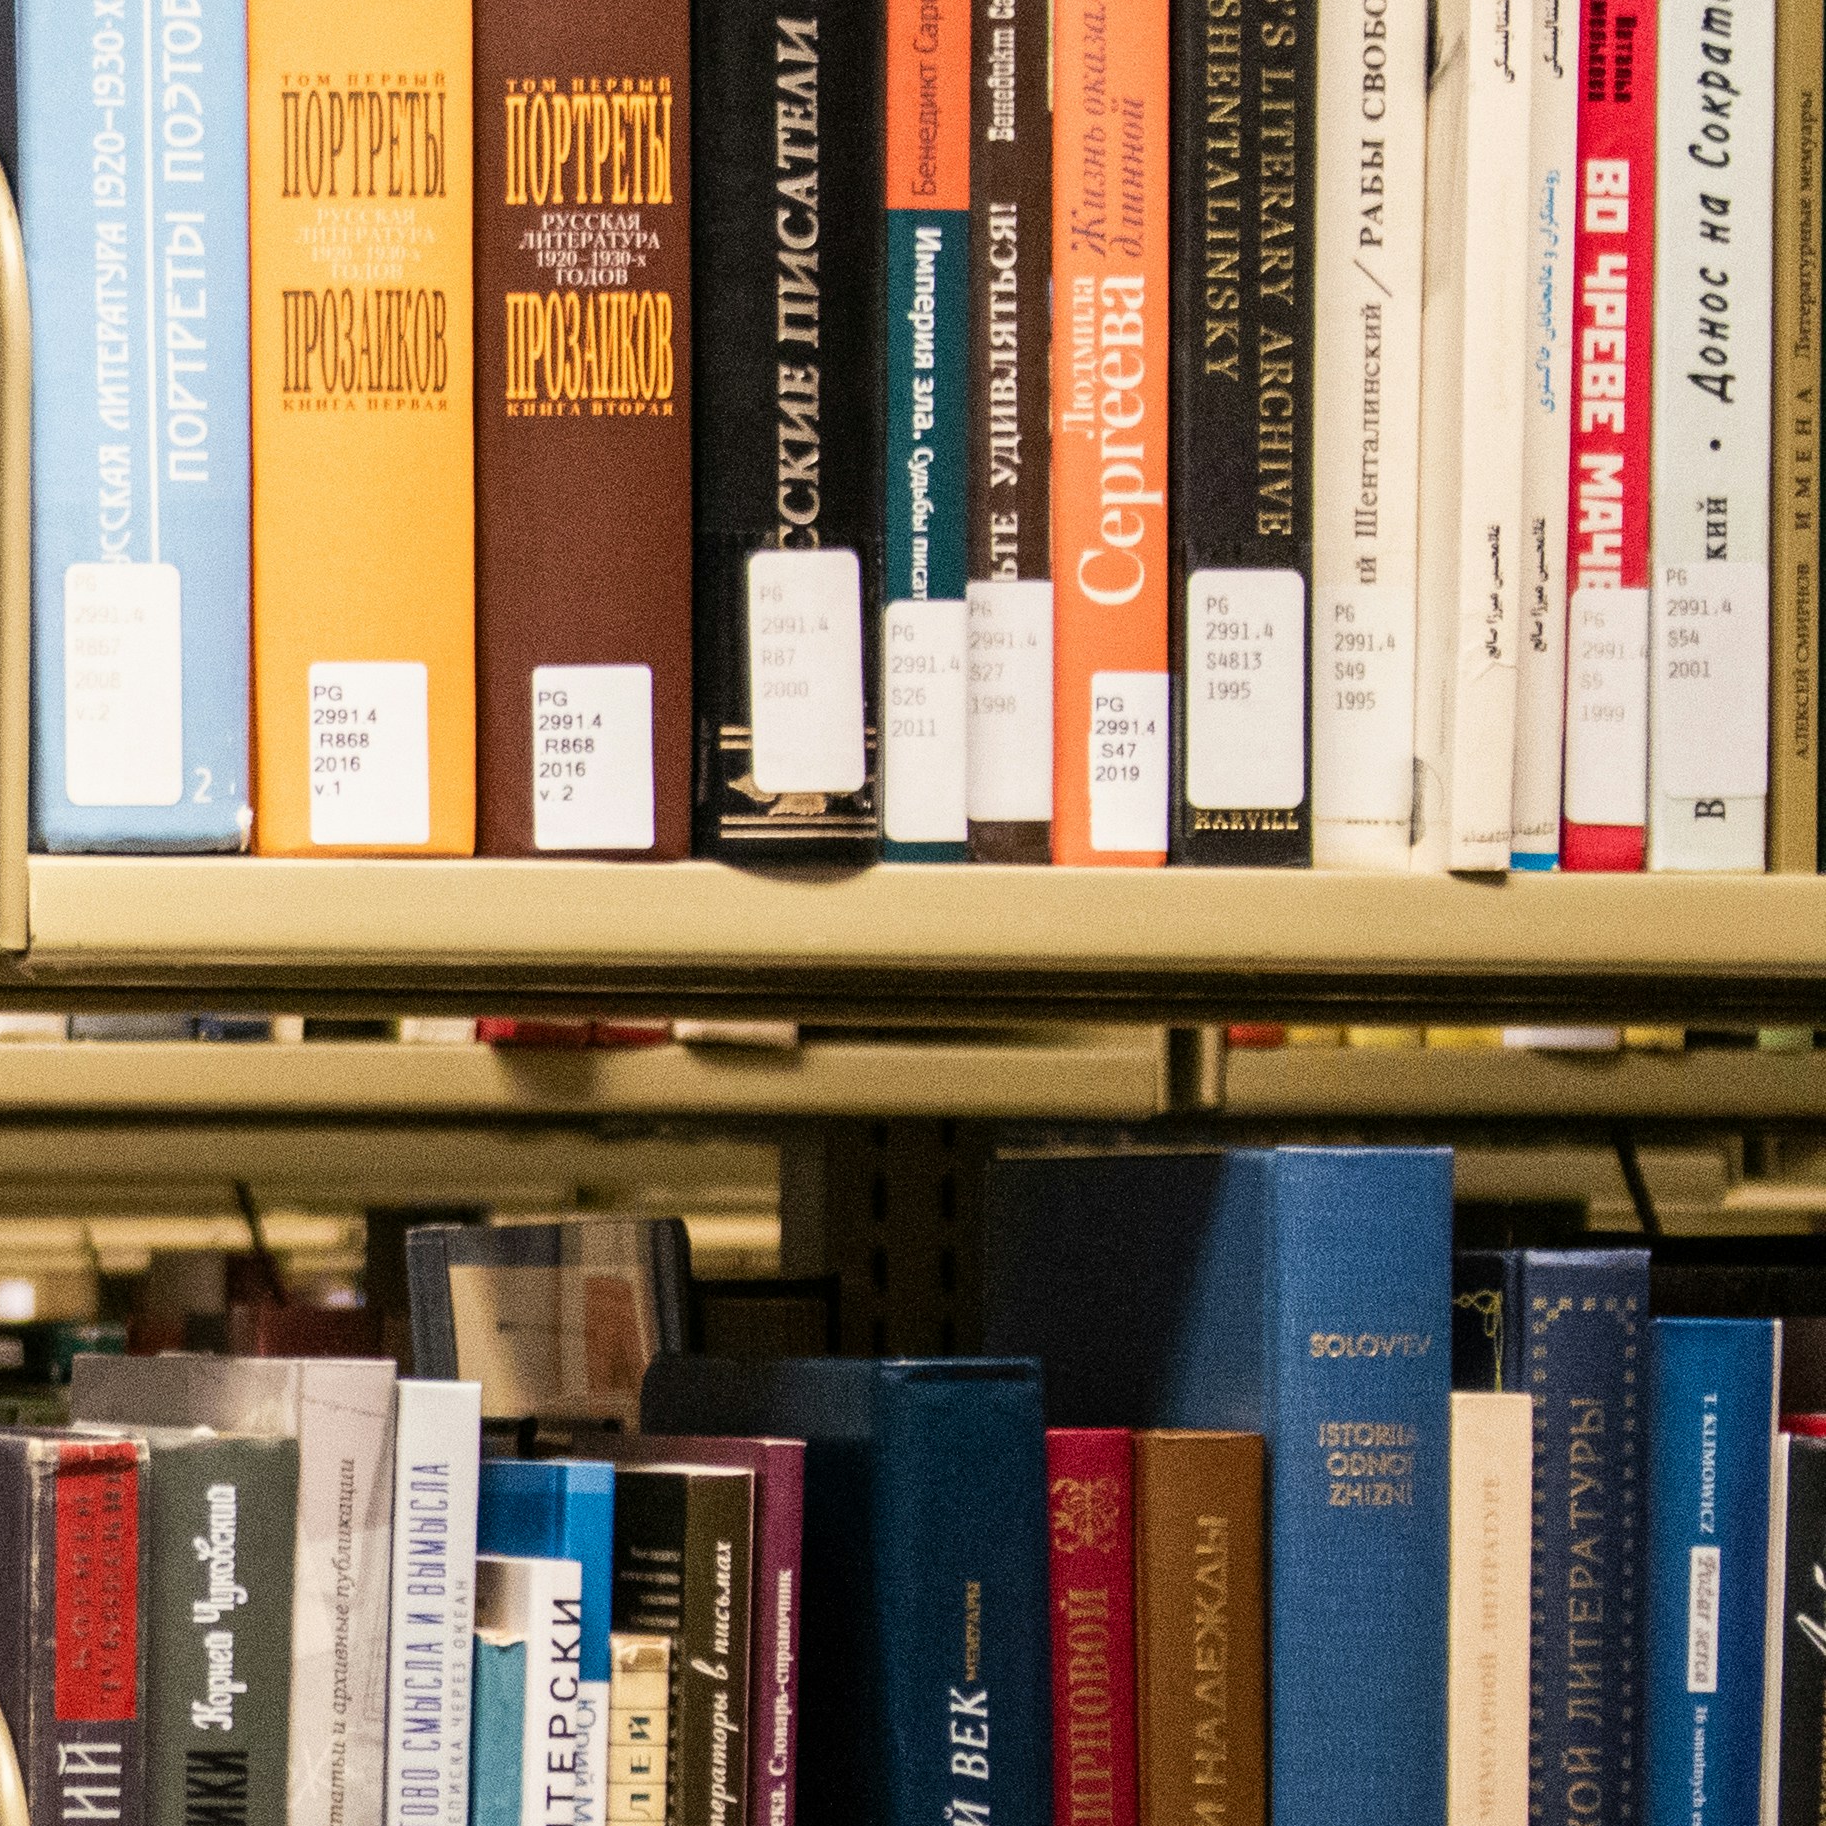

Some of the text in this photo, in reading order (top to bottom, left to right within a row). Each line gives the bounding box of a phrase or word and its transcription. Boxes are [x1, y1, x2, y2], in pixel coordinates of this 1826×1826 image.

[281, 71, 447, 88] ТОМ ПЕРВЫЙ
[506, 76, 671, 94] ТОМ ПЕРВЫЙ
[912, 61, 940, 198] Бенедикт
[281, 90, 447, 198] ПОРТРЕТЫ
[505, 94, 673, 205] ПОРТРЕТЫ
[776, 17, 821, 348] ПИСАТЕЛИ
[1206, 0, 1241, 382] SHENTALINSKY
[518, 230, 660, 251] ЛИТЕРАТУРА
[540, 212, 641, 231] РУССКАЯ
[95, 220, 131, 431] ЛИТЕРАТУРА
[556, 268, 629, 287] ГОДОВ
[908, 227, 942, 369] Империя
[1258, 67, 1296, 536] LITERARY ARCHIVE
[1580, 159, 1630, 434] ВО ЧРЕВЕ
[1687, 193, 1736, 404] Донос на
[164, 211, 210, 482] ПОРТРЕТЫ
[281, 289, 447, 394] ПРОЗАИКОВ
[505, 291, 674, 400] ПРОЗАИКОВ
[989, 203, 1022, 488] УДИВЛЯТЬСЯ!
[1061, 275, 1096, 440] Людмила
[1351, 138, 1385, 540] Шенталинский РАБЫ
[283, 398, 356, 412] КНИГА
[506, 400, 674, 417] КНИГА ВТОРАЯ
[1077, 273, 1163, 606] Сергеева
[1206, 597, 1229, 616] PG
[314, 686, 344, 701] PG
[314, 709, 378, 725] 2991.4
[539, 690, 568, 706] PG
[539, 713, 602, 730] 2991.4
[1095, 697, 1124, 713] PG
[1095, 720, 1156, 736] 2991.4
[193, 767, 213, 805] 2
[314, 757, 361, 772] 2016
[539, 762, 586, 778] 2016
[1095, 766, 1140, 782] 2019
[406, 1463, 451, 1596] ВЫМЫСЛА
[1566, 1396, 1605, 1726] ЛИТЕРАТУРЫ
[401, 1642, 445, 1752] СМЫСЛА
[949, 1688, 990, 1781] ВЕК
